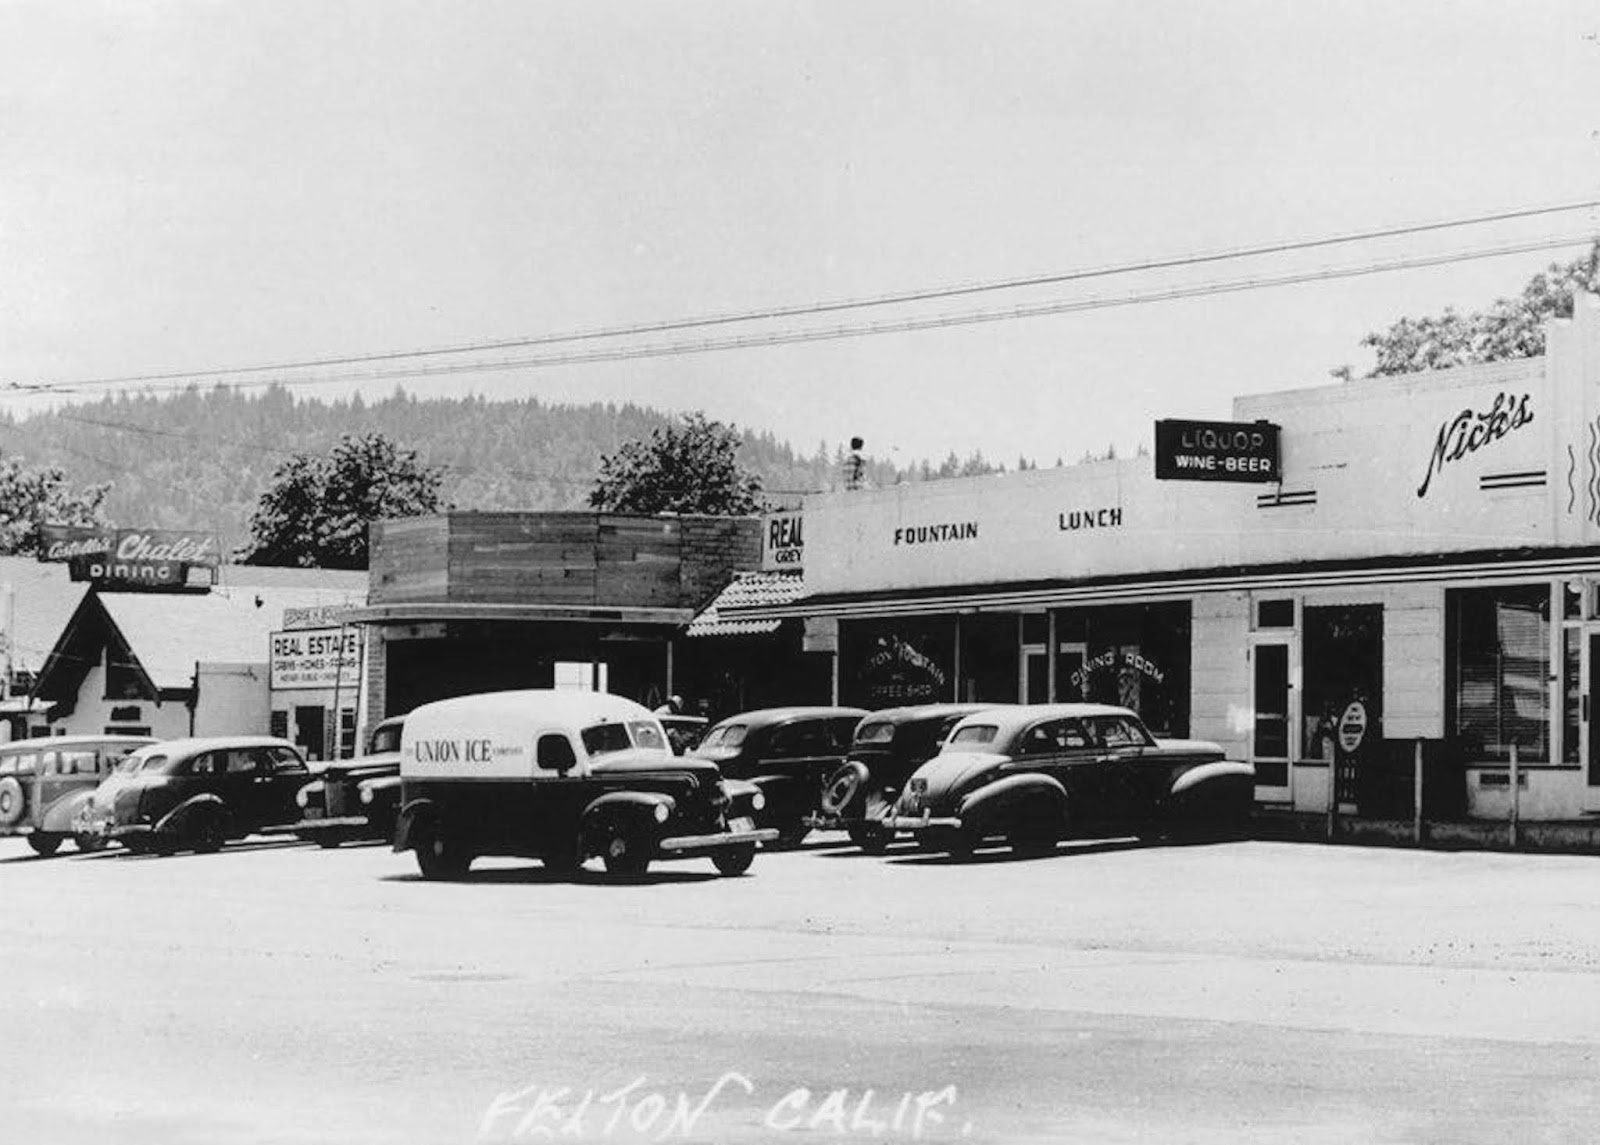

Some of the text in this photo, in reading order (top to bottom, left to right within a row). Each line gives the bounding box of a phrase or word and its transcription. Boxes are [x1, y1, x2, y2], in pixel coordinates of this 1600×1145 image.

[1181, 429, 1264, 450] LIQUOR
[1417, 391, 1534, 498] Nick's
[1175, 454, 1272, 472] WINE-BEER
[1059, 507, 1122, 531] LUNCH
[770, 516, 804, 549] REAL
[894, 521, 978, 546] FOUNTAIN
[275, 634, 355, 656] REAL ESTATE
[1125, 653, 1164, 683] ROOM
[415, 739, 459, 763] UNION
[465, 739, 492, 763] ICE
